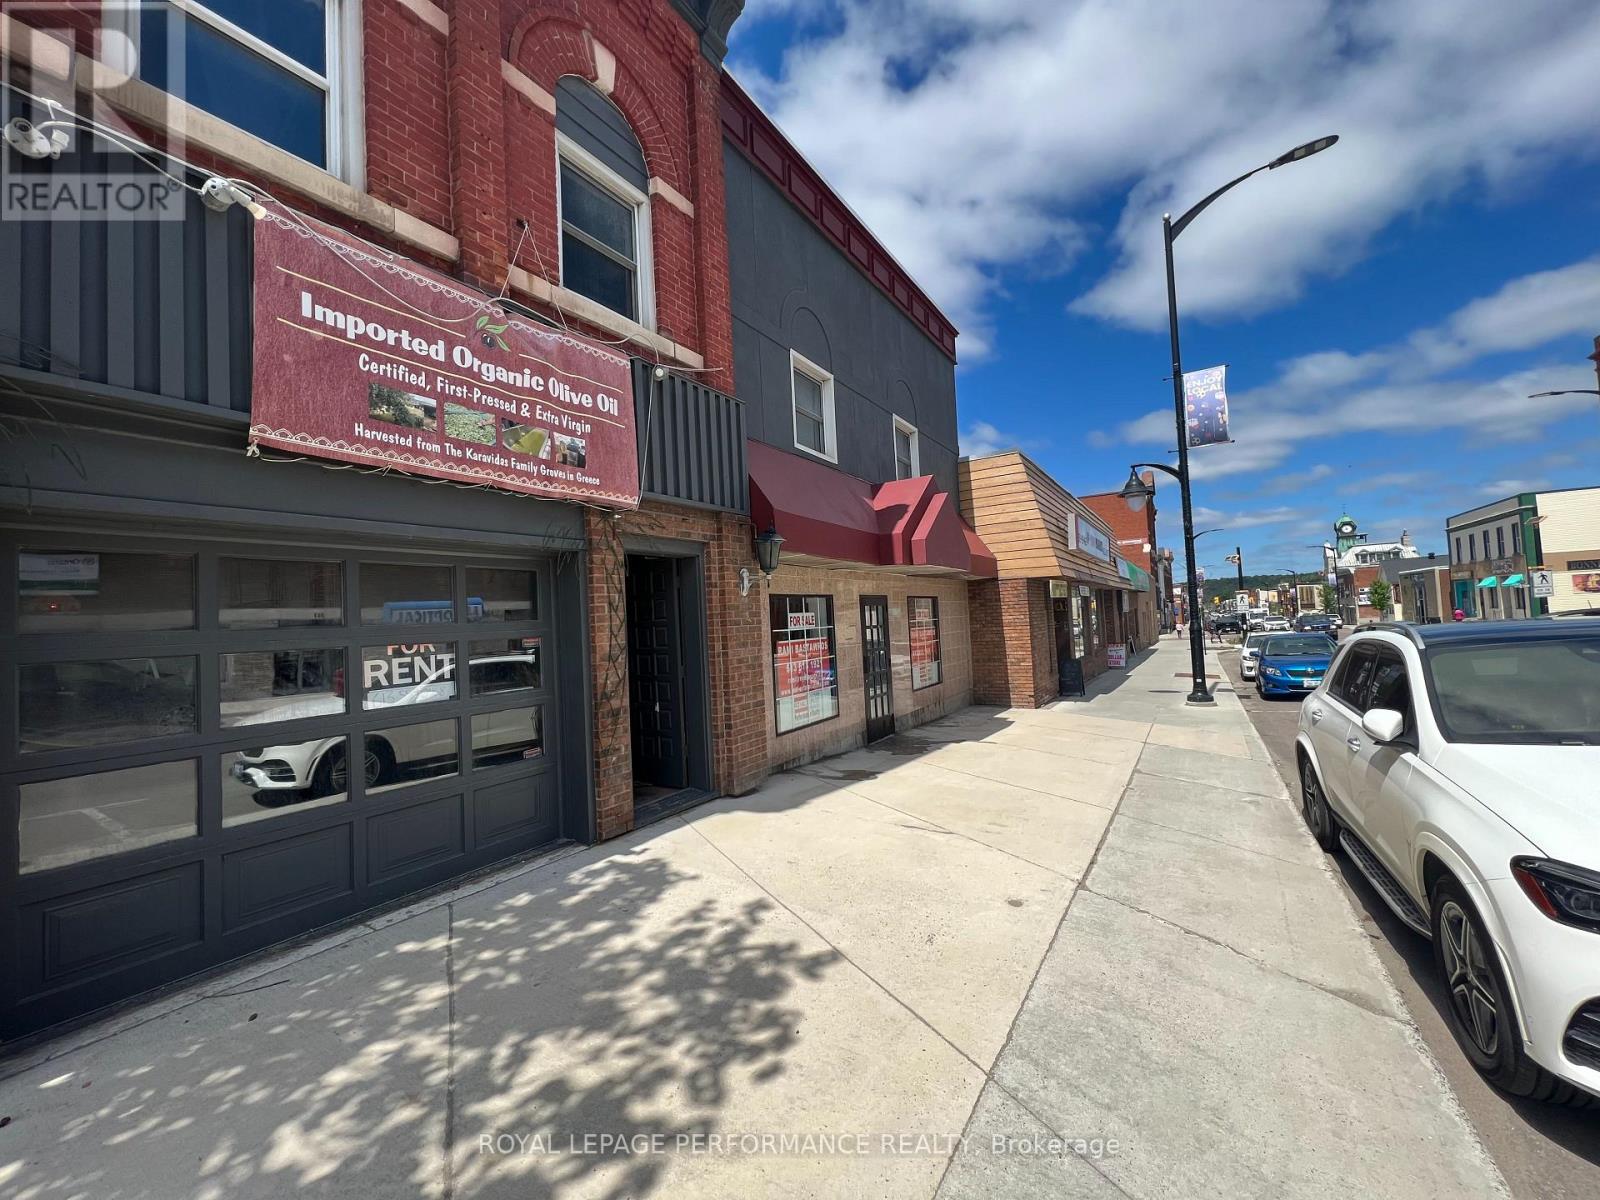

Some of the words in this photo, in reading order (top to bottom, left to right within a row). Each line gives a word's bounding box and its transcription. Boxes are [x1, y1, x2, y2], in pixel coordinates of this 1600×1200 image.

[301, 291, 445, 362] Imported
[452, 345, 544, 392] Organic
[548, 377, 593, 407] Olive
[596, 393, 618, 416] Oil
[358, 353, 431, 391] Certified,
[437, 376, 517, 415] First-Pressed
[521, 403, 531, 418] &
[535, 405, 559, 426] Extra
[562, 415, 591, 435] Virgin
[354, 422, 413, 447] Harvested
[416, 436, 441, 453] from
[444, 443, 463, 458] The
[466, 447, 509, 467] Karavidas
[511, 458, 538, 476] Family
[540, 464, 566, 479] Groves
[567, 470, 574, 480] in
[576, 472, 600, 486] Greece
[790, 616, 801, 627] FOR
[363, 653, 456, 688] RENT
